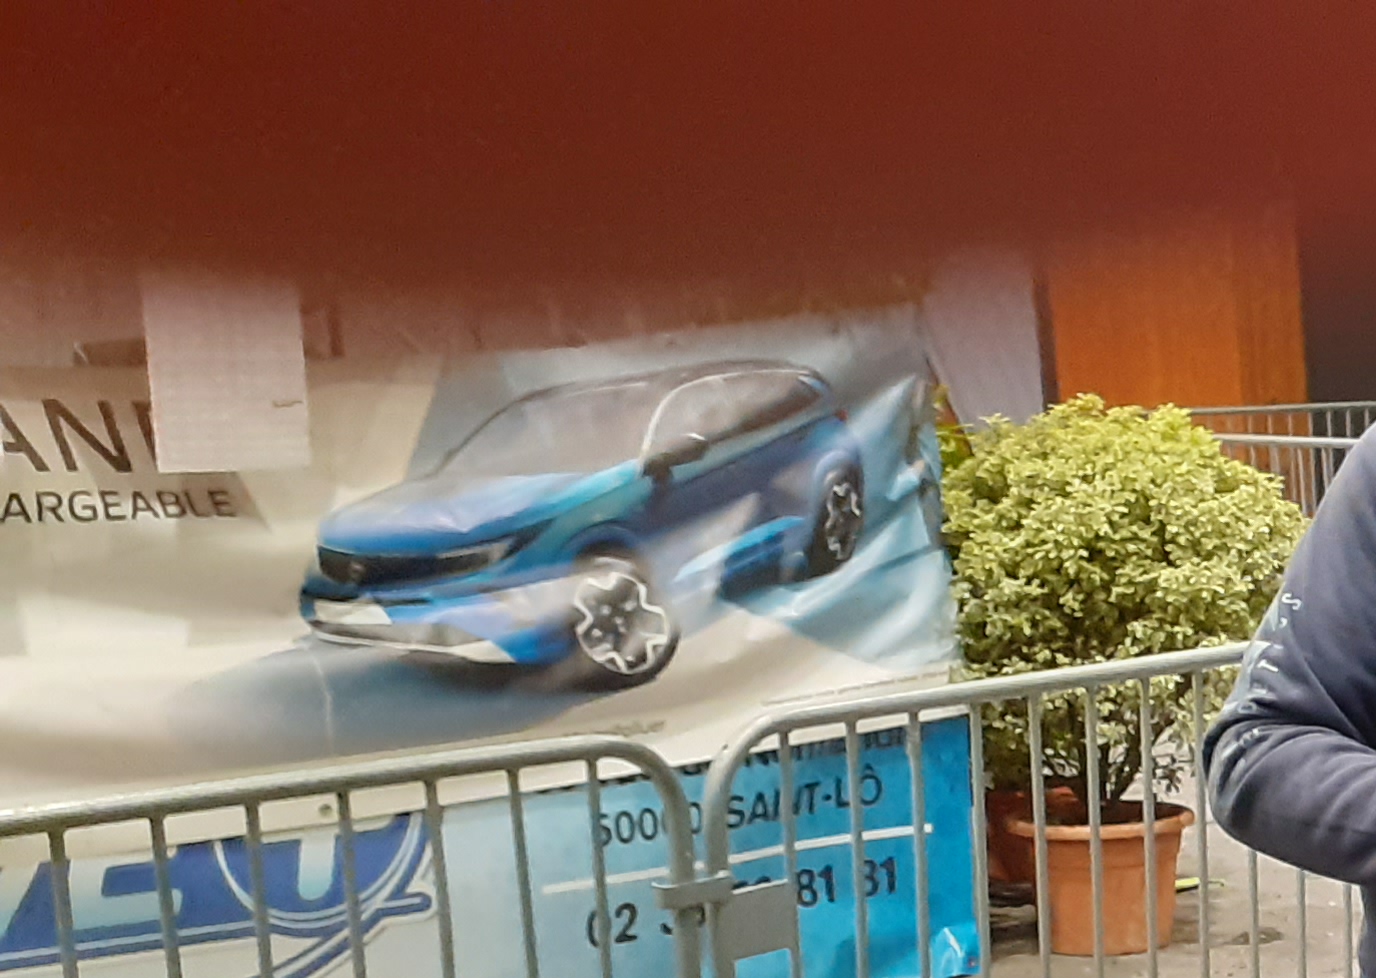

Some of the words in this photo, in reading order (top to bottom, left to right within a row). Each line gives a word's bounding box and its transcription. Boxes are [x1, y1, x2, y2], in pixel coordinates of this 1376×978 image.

[0, 398, 157, 473] AN
[0, 490, 238, 524] ARGEABLE
[596, 801, 702, 848] 5000
